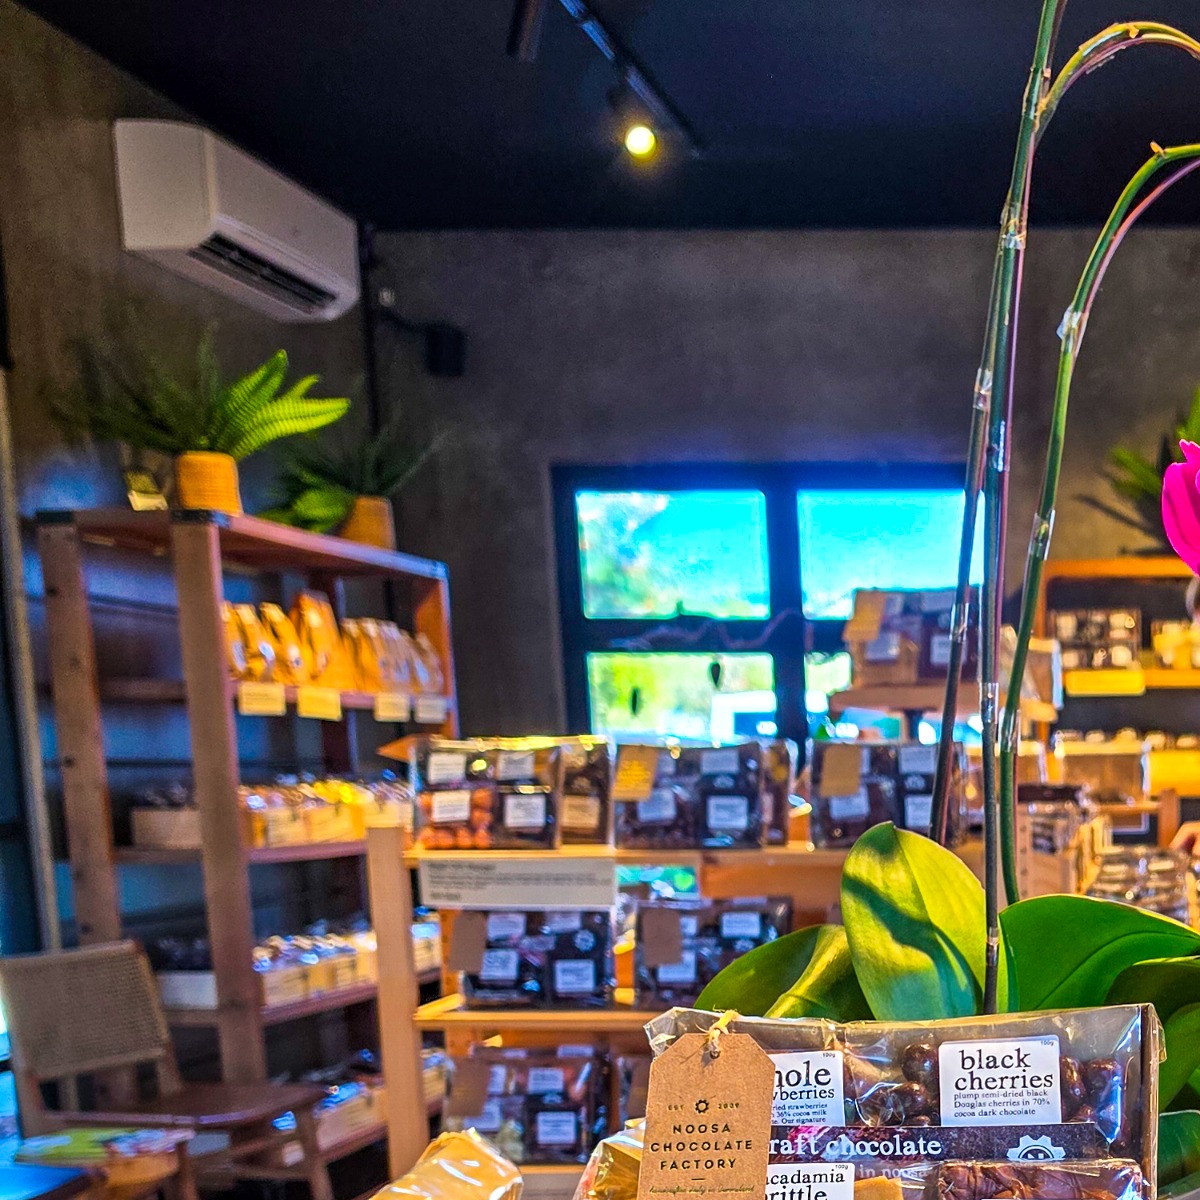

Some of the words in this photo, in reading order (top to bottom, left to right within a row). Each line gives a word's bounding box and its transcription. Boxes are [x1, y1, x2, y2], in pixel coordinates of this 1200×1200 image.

[959, 1048, 1031, 1070] black
[955, 1070, 1053, 1090] cherries
[954, 1092, 980, 1100] plump
[982, 1090, 1024, 1098] semi-dried
[978, 1109, 996, 1117] dark
[999, 1108, 1035, 1116] chocolate
[673, 1124, 731, 1134] NOOSA
[651, 1140, 752, 1151] CHOCOLATE
[661, 1159, 736, 1170] FACTORY
